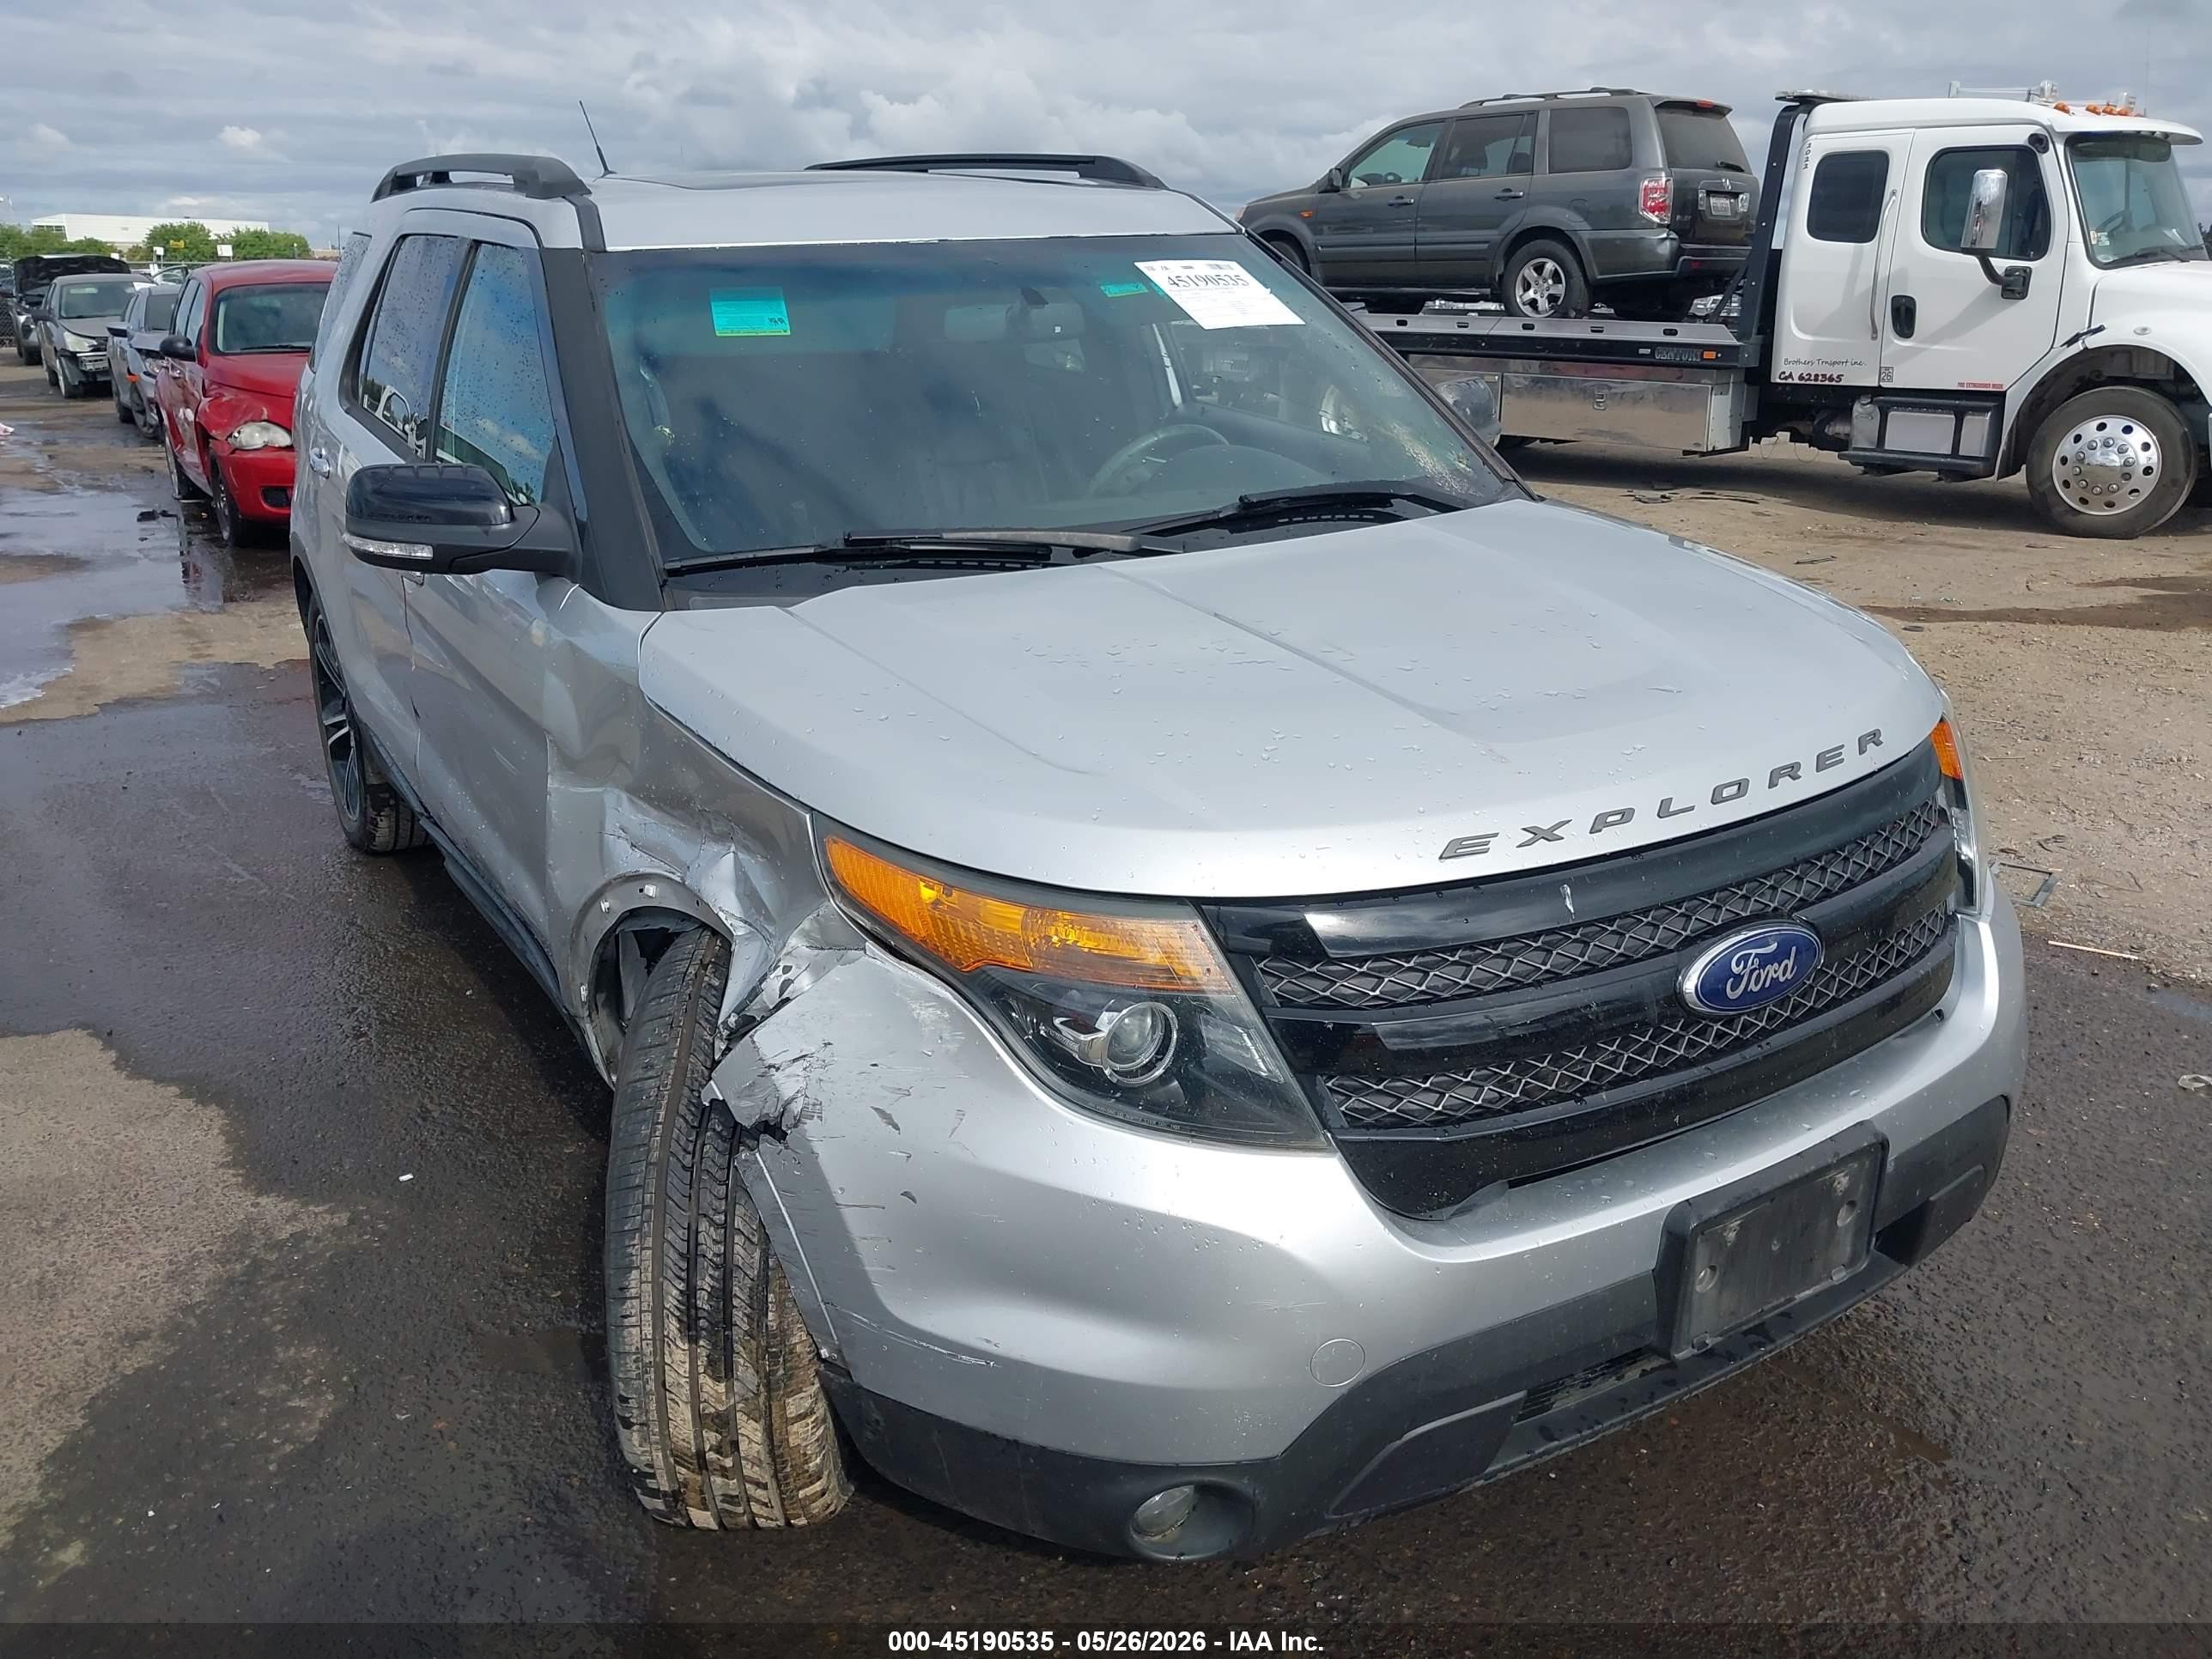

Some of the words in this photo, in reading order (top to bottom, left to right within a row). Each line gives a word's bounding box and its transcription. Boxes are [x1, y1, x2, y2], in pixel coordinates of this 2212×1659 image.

[1168, 274, 1249, 288] 45190535
[1784, 357, 1814, 367] Brothers
[1778, 371, 1795, 381] CA
[1797, 372, 1844, 383] 628365
[1881, 371, 1892, 381] 26
[1438, 728, 1884, 860] EXPLORER
[1725, 940, 1797, 1000] Ford
